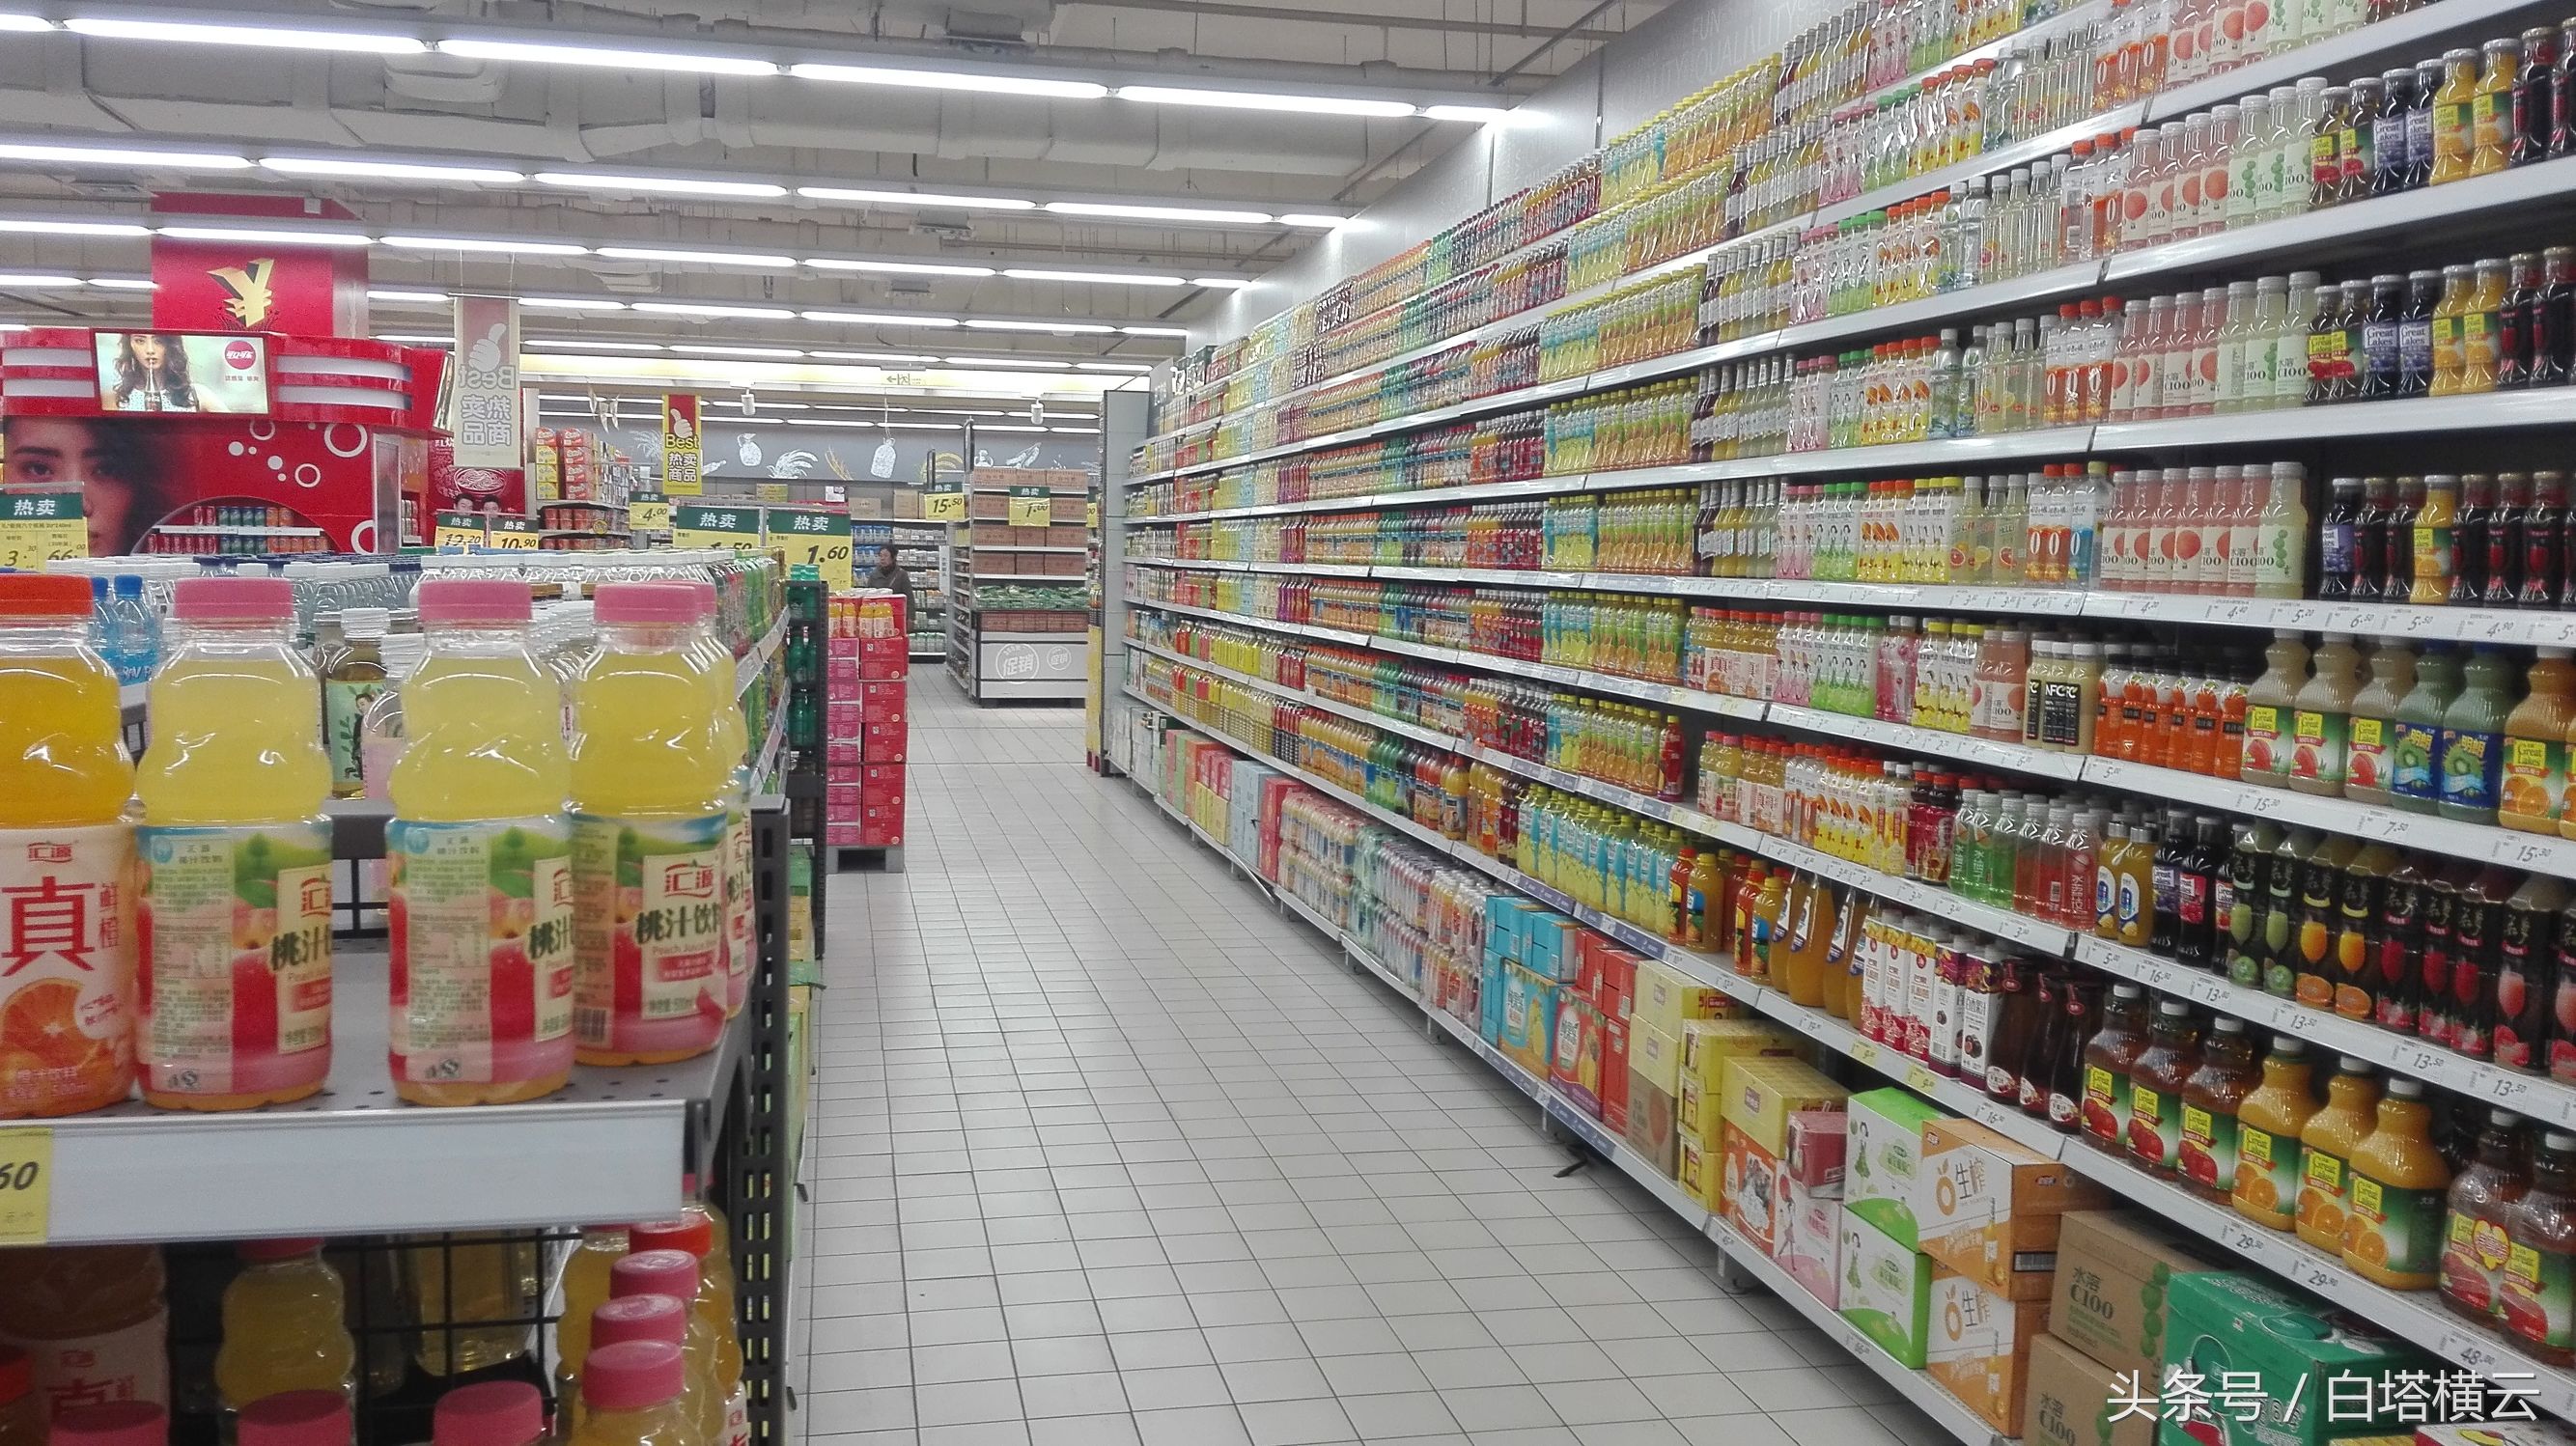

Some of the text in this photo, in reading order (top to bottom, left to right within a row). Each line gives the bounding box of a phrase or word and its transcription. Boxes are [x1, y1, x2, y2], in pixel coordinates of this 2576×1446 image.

[2366, 328, 2394, 340] Great
[2401, 327, 2426, 339] Great
[2367, 337, 2394, 347] Lakes
[2401, 336, 2425, 347] Lakes
[664, 434, 700, 450] Best
[667, 452, 698, 467] 热卖
[667, 467, 698, 483] 商品
[640, 492, 658, 502] 热卖
[1021, 487, 1040, 496] 热卖
[14, 499, 56, 515] 热卖
[933, 497, 963, 514] 15.50
[451, 516, 472, 527] 热卖
[642, 508, 667, 522] 4.00
[699, 513, 737, 529] 热卖
[503, 520, 526, 531] 热卖
[793, 515, 829, 532] 热卖
[807, 544, 849, 565] 1.60
[1003, 653, 1034, 676] 促销
[2518, 746, 2542, 757] Great
[2518, 755, 2541, 765] Lakes
[664, 870, 714, 892] 汇源
[1, 876, 96, 977] 真
[529, 914, 573, 960] 桃汁
[2069, 1284, 2114, 1321] C100
[2038, 1409, 2076, 1446] C100
